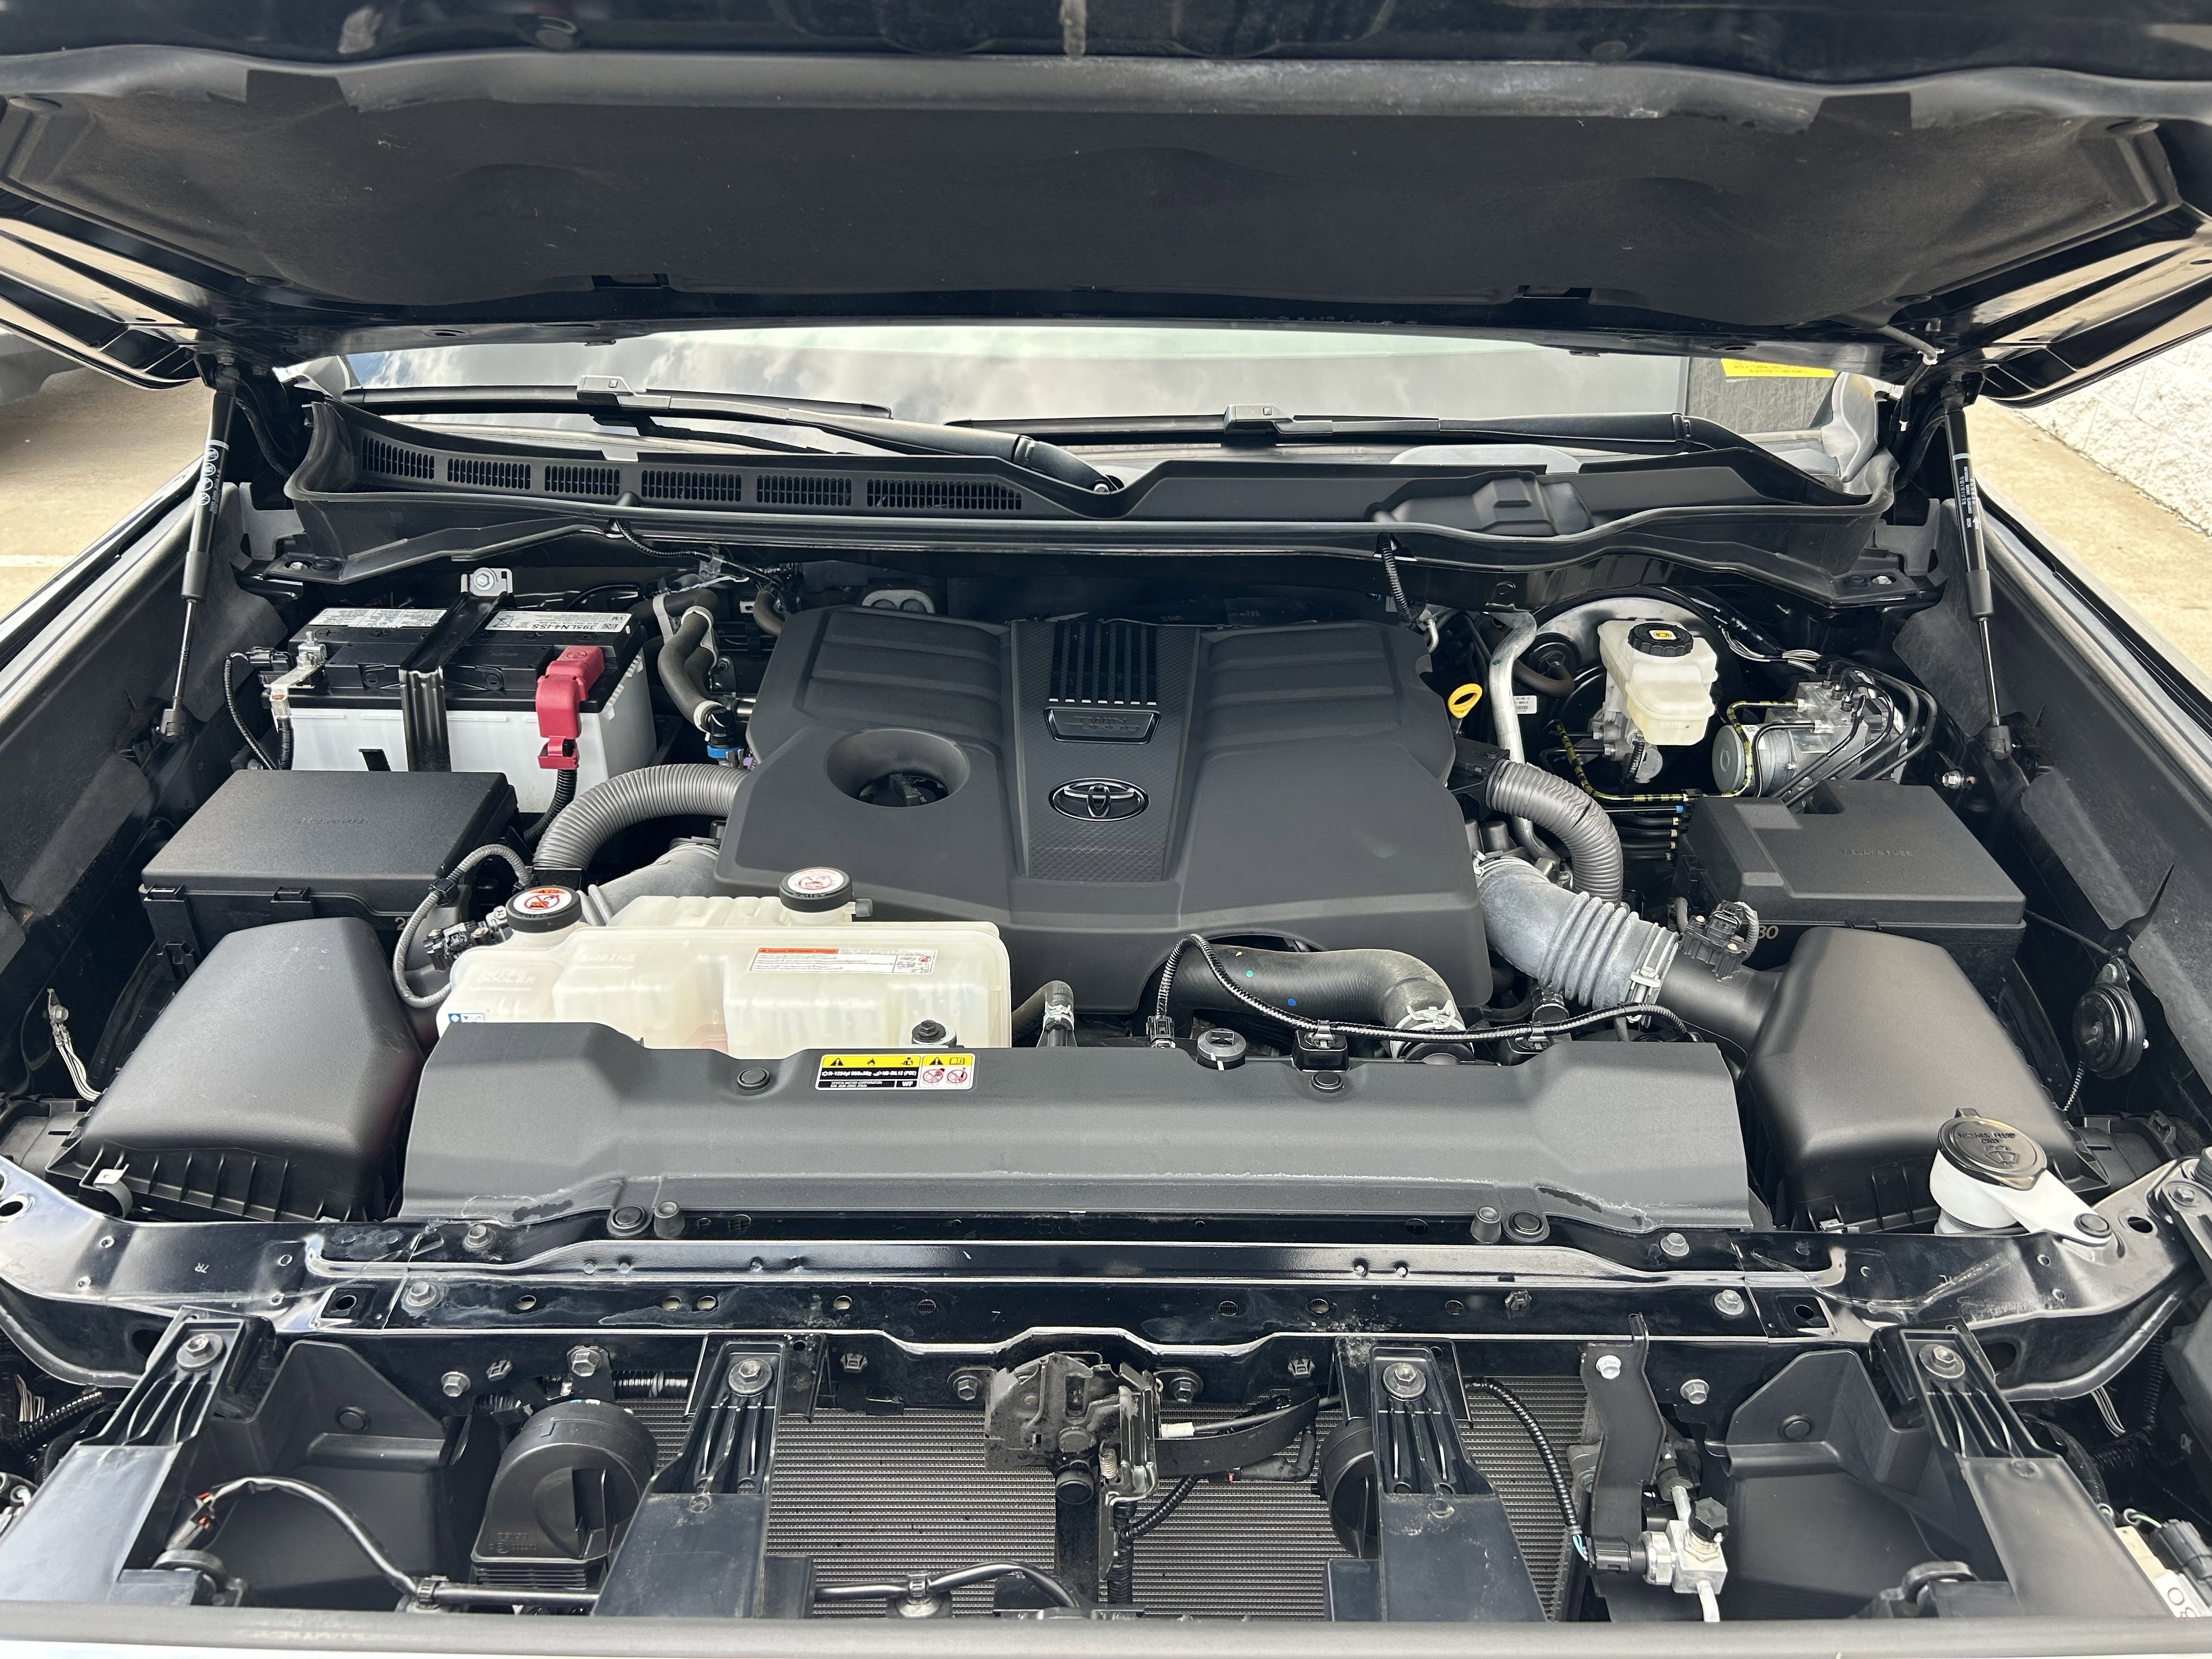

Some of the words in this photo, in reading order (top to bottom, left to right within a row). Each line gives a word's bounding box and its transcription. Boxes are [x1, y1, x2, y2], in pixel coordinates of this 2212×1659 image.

[1074, 715, 1127, 724] TWIN
[1063, 722, 1141, 731] TURBO
[395, 917, 411, 930] 2
